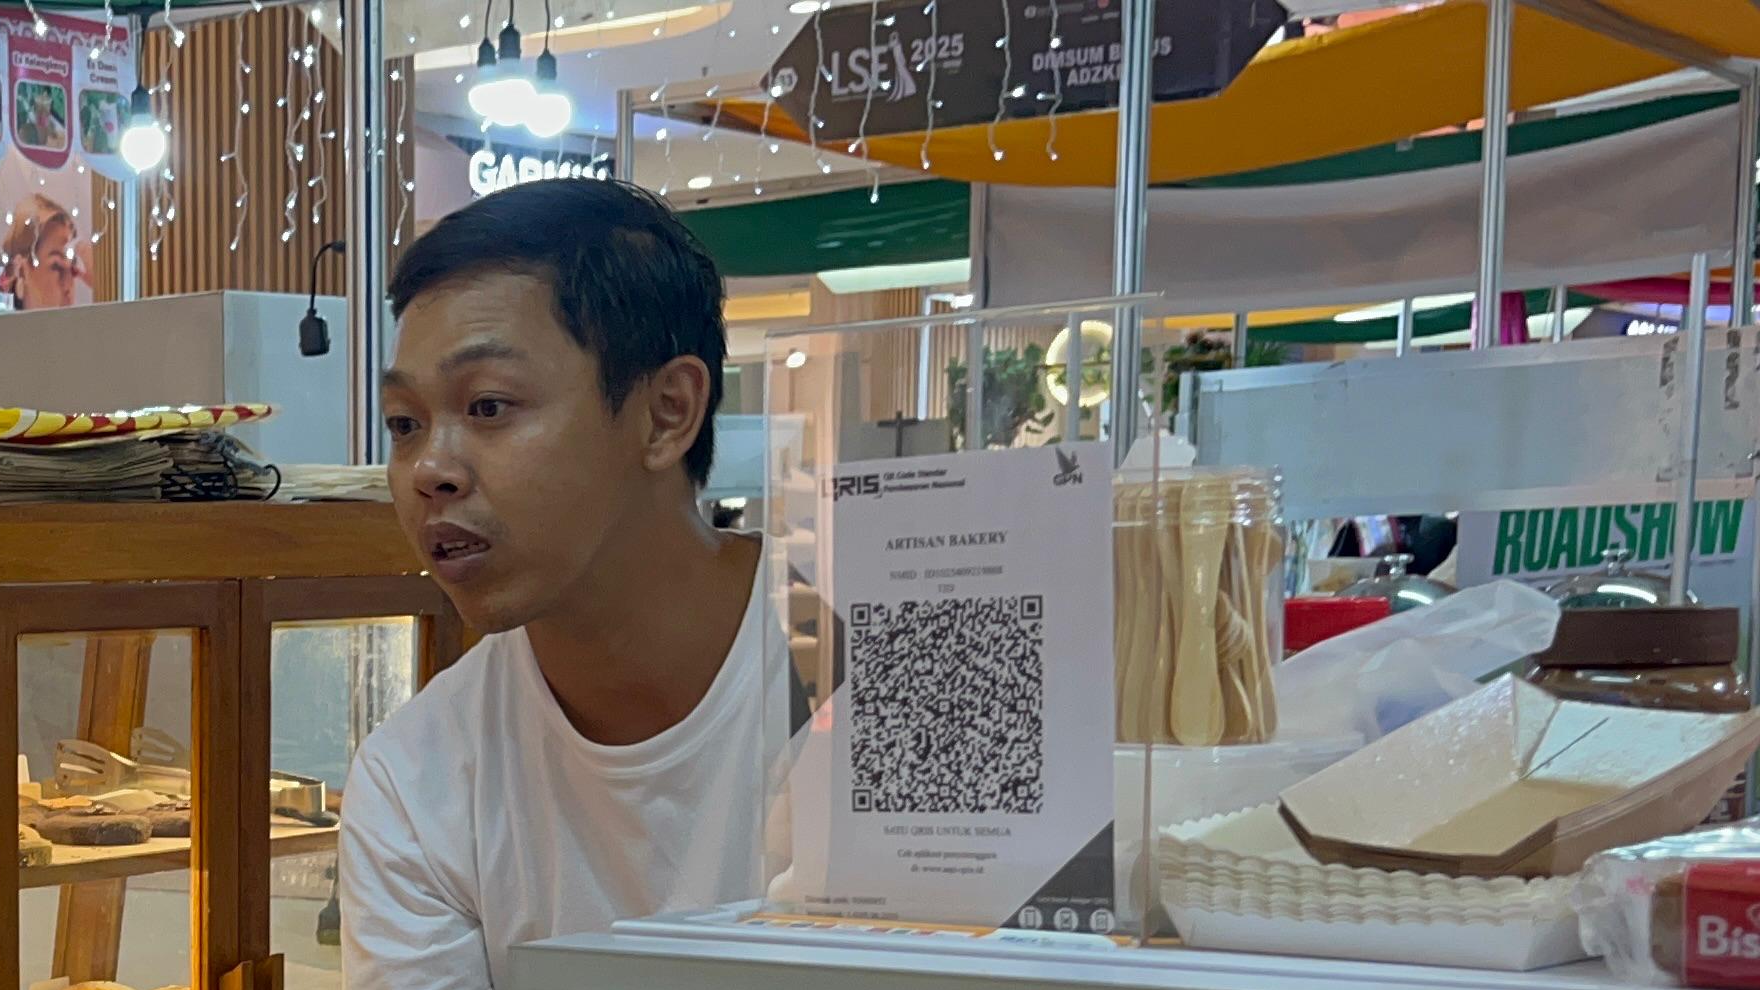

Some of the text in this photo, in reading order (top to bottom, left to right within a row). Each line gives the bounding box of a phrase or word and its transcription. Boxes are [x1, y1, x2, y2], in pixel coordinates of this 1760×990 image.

[911, 33, 964, 63] 2025
[1032, 44, 1106, 73] DIMSUM
[885, 530, 1008, 551] ARTISAN BAKERY
